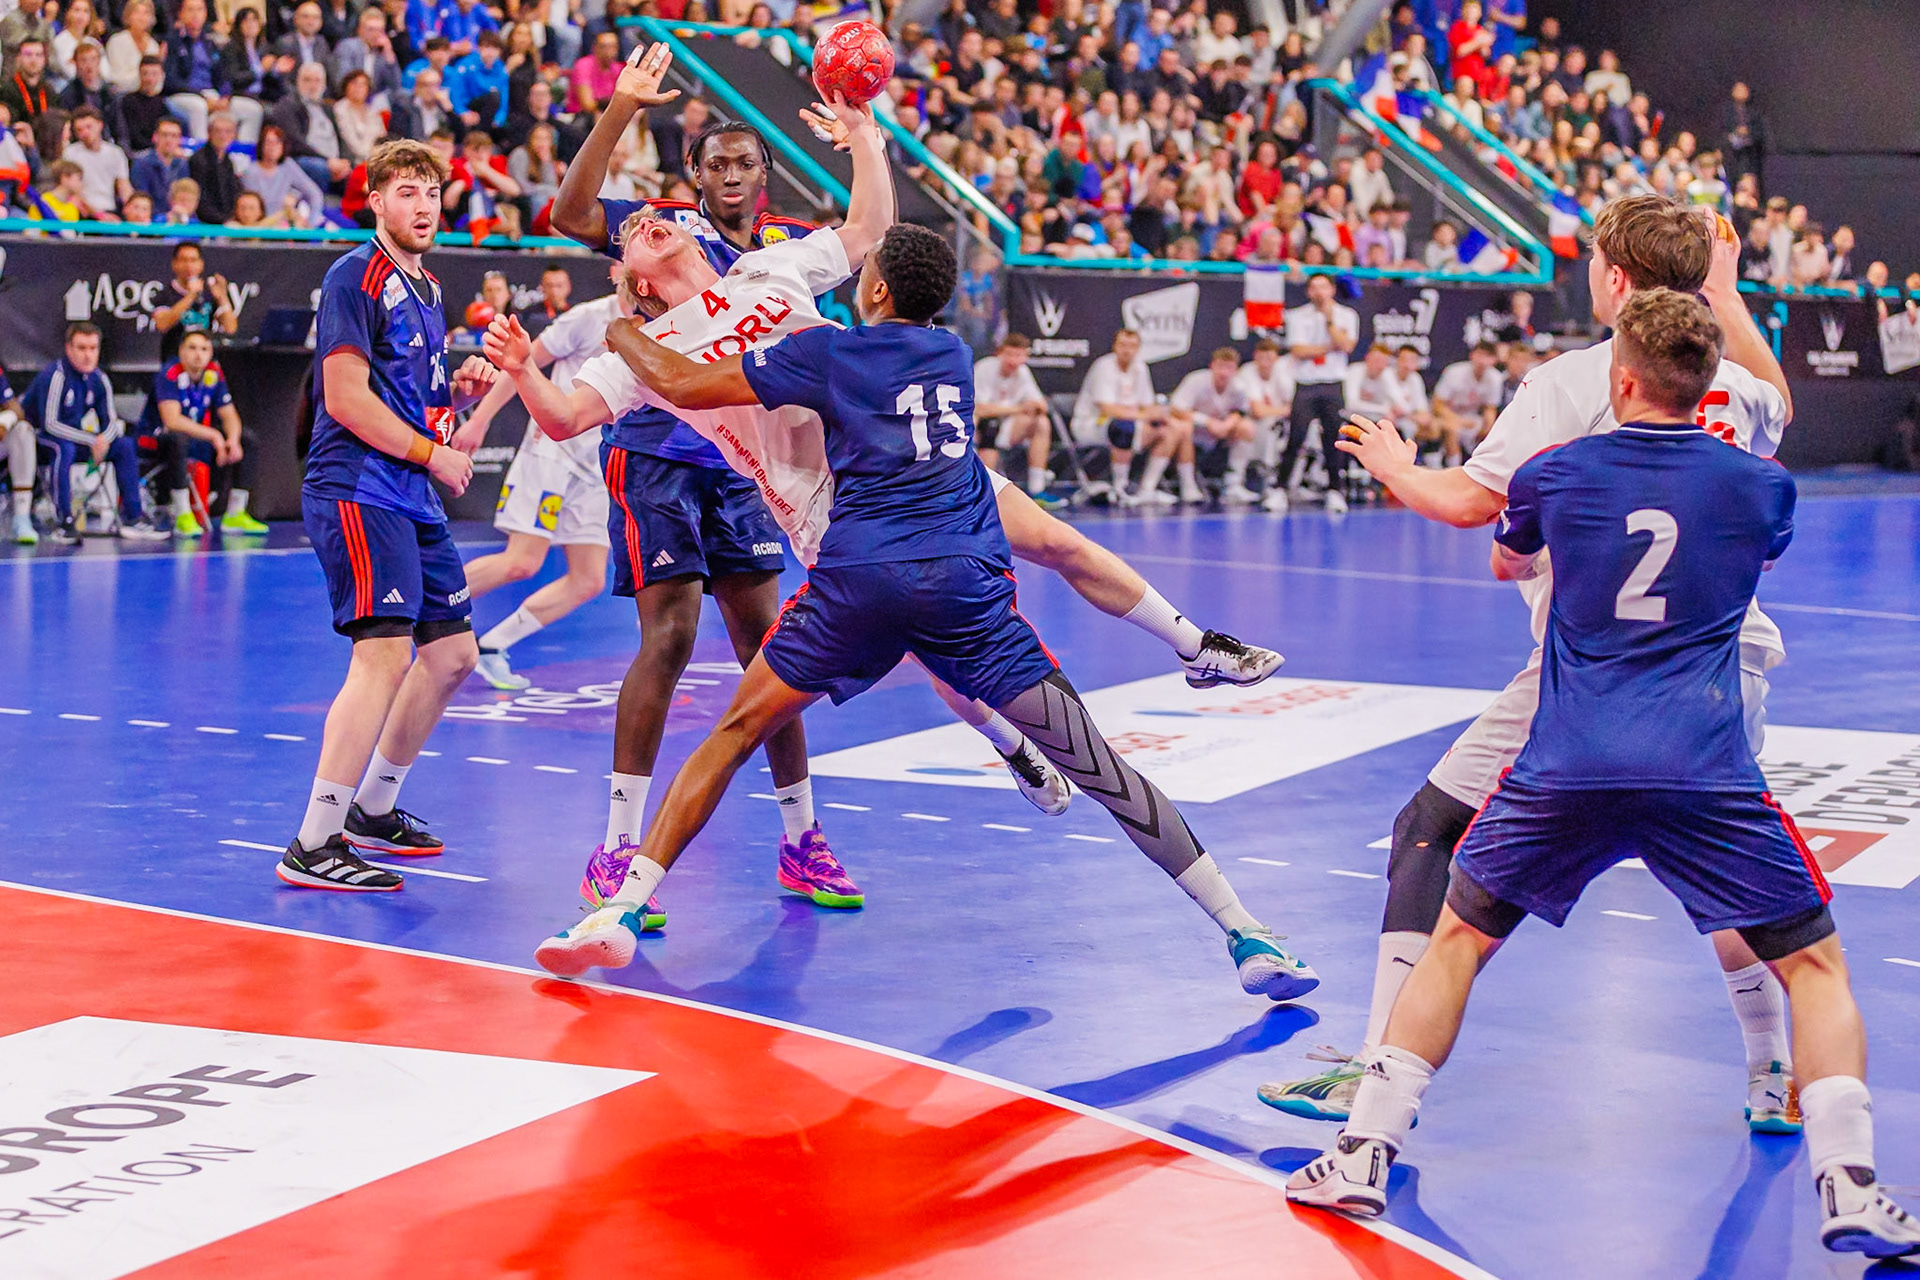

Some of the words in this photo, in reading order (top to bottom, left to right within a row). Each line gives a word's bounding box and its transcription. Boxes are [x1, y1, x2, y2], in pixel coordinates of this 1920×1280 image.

[700, 289, 731, 318] 4
[895, 383, 970, 461] 15
[1614, 508, 1679, 622] 2
